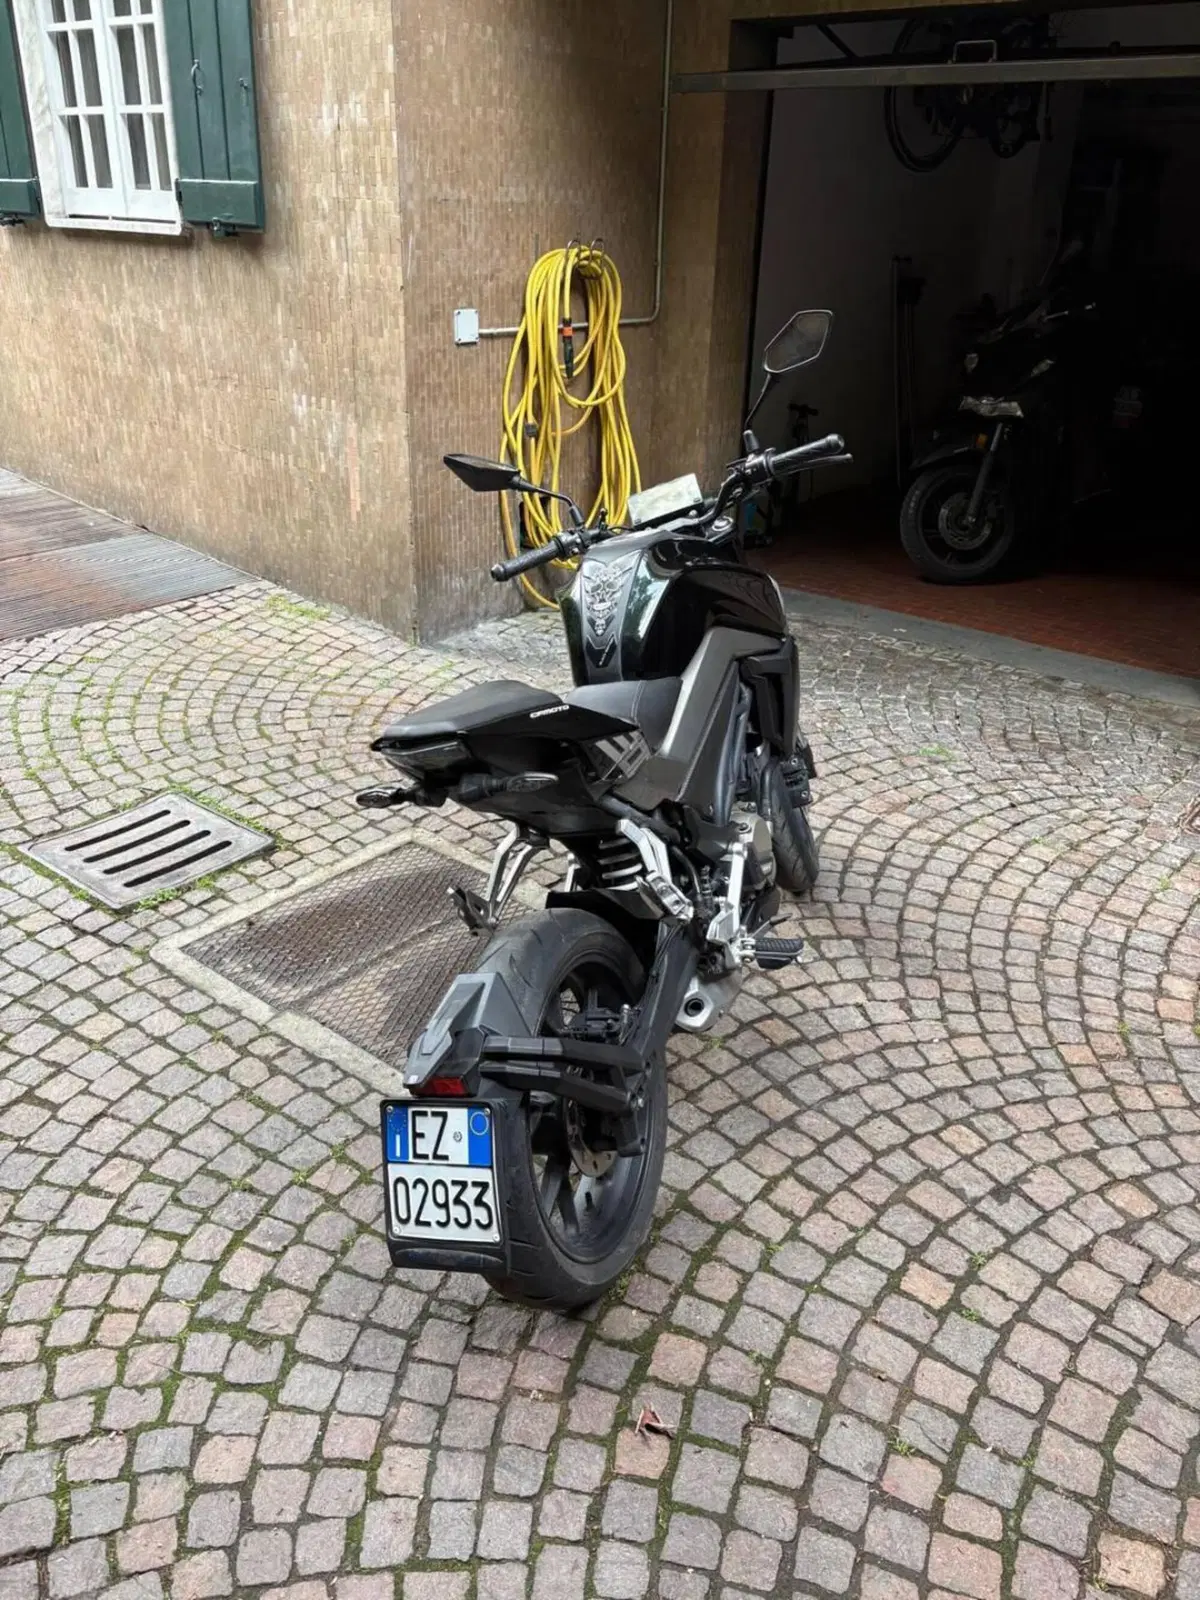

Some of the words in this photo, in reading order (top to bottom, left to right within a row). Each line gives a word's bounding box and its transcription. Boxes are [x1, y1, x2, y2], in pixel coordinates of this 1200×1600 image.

[395, 1134, 401, 1158] I
[411, 1110, 449, 1161] EZ
[393, 1176, 493, 1230] 02933
